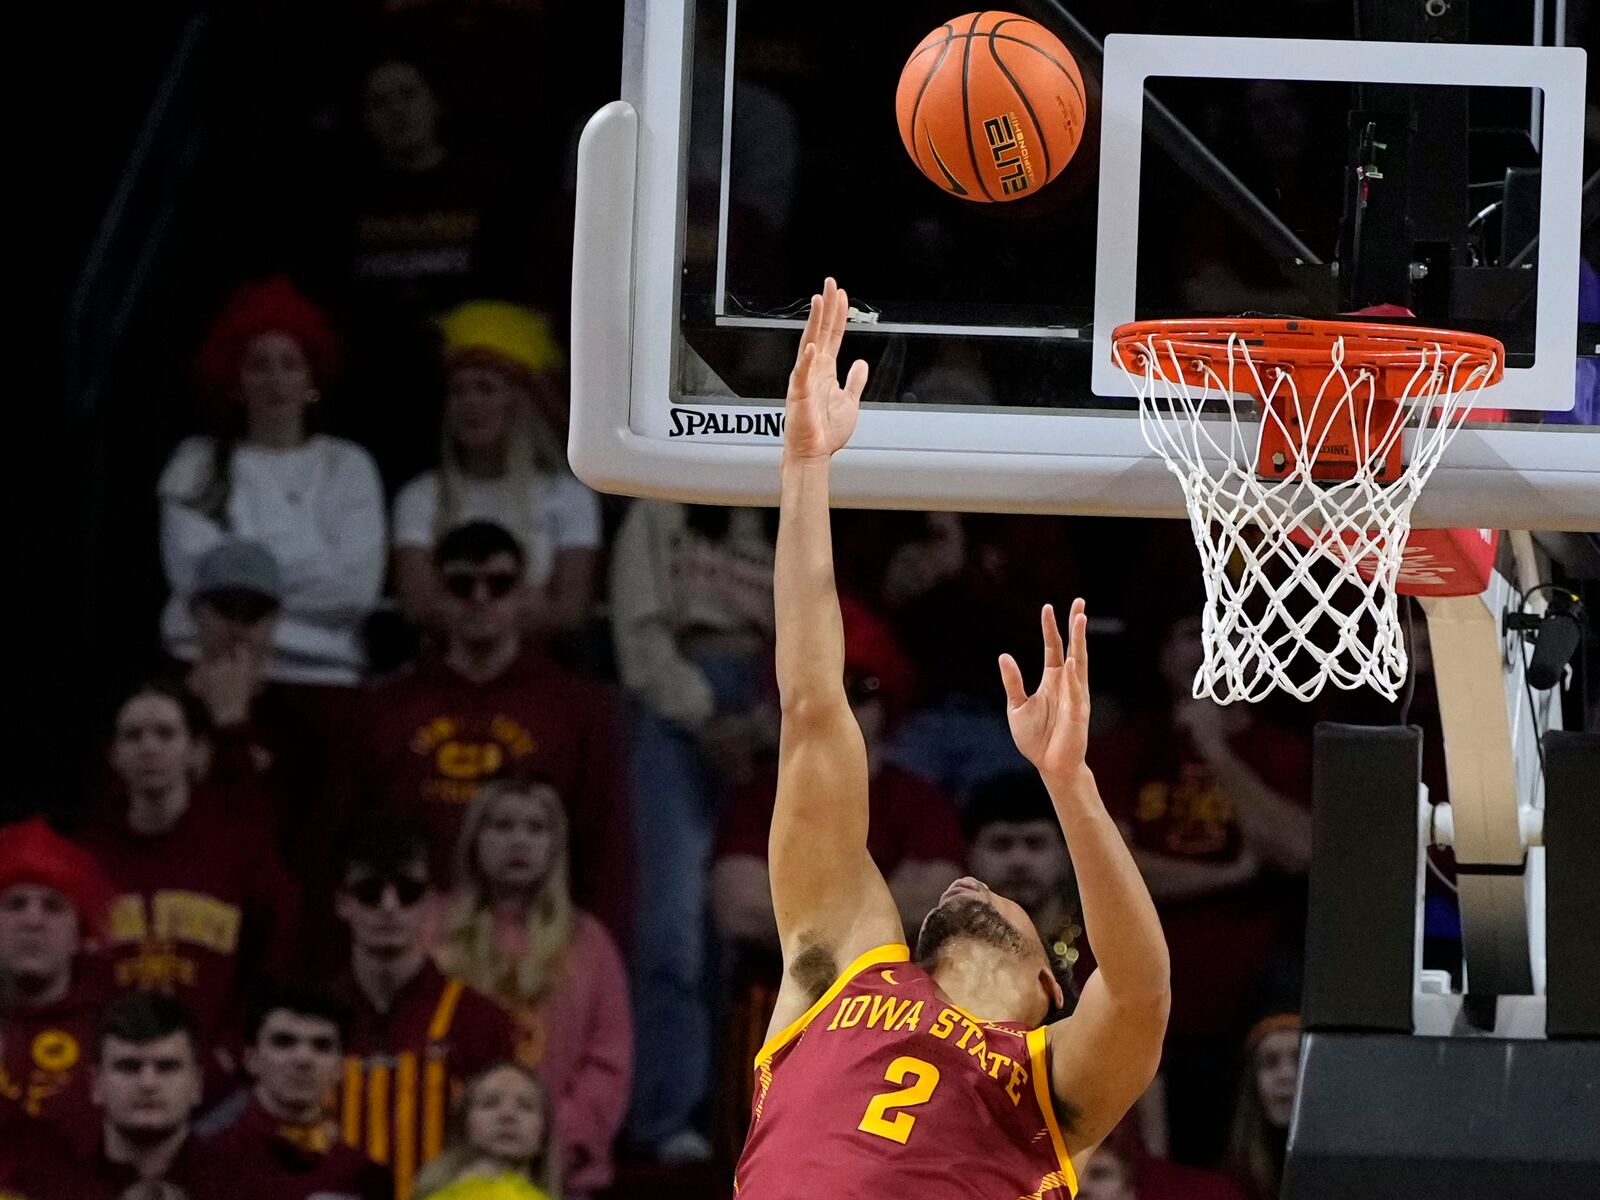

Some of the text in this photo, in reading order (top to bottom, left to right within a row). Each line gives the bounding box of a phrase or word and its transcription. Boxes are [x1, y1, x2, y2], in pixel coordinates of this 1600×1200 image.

[983, 114, 1028, 196] ELITE
[669, 407, 786, 438] SPALDIN
[826, 994, 1028, 1107] IOWA STATE
[857, 1055, 941, 1145] 2
